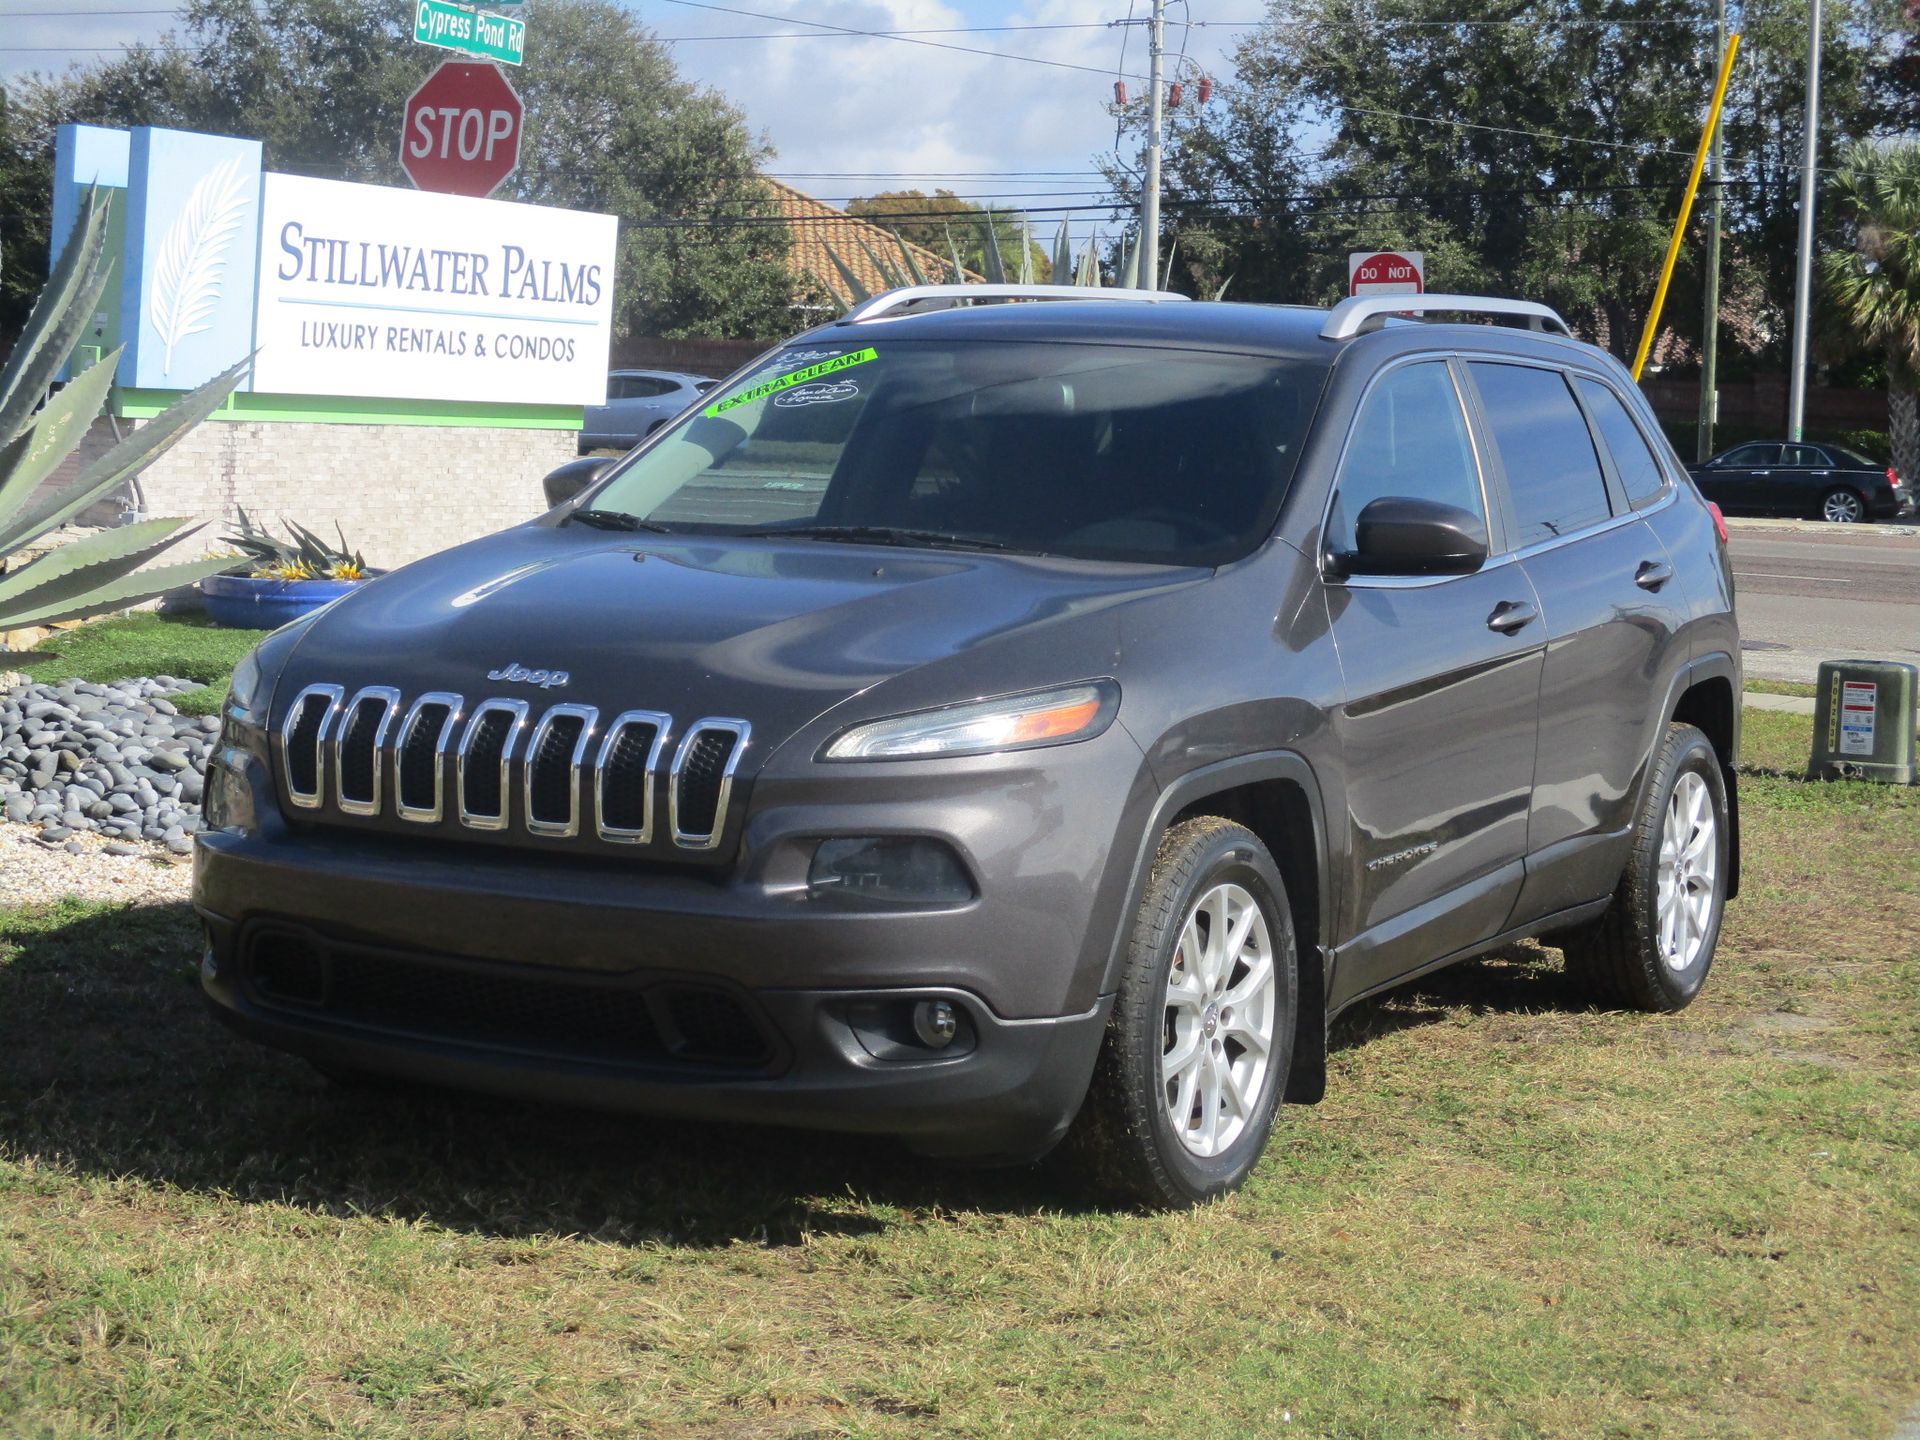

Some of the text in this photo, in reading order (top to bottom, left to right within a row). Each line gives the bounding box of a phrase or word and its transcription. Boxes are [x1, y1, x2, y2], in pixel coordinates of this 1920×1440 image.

[418, 1, 523, 53] Cypress Pond Rd
[409, 106, 514, 161] STOP
[1360, 266, 1412, 280] DO NOT
[301, 320, 575, 363] LUXURY RENTALS & CONDOS
[716, 352, 866, 413] EXTRA CLEAN
[487, 662, 570, 689] Jeep
[1366, 841, 1438, 871] CHEROKEE
